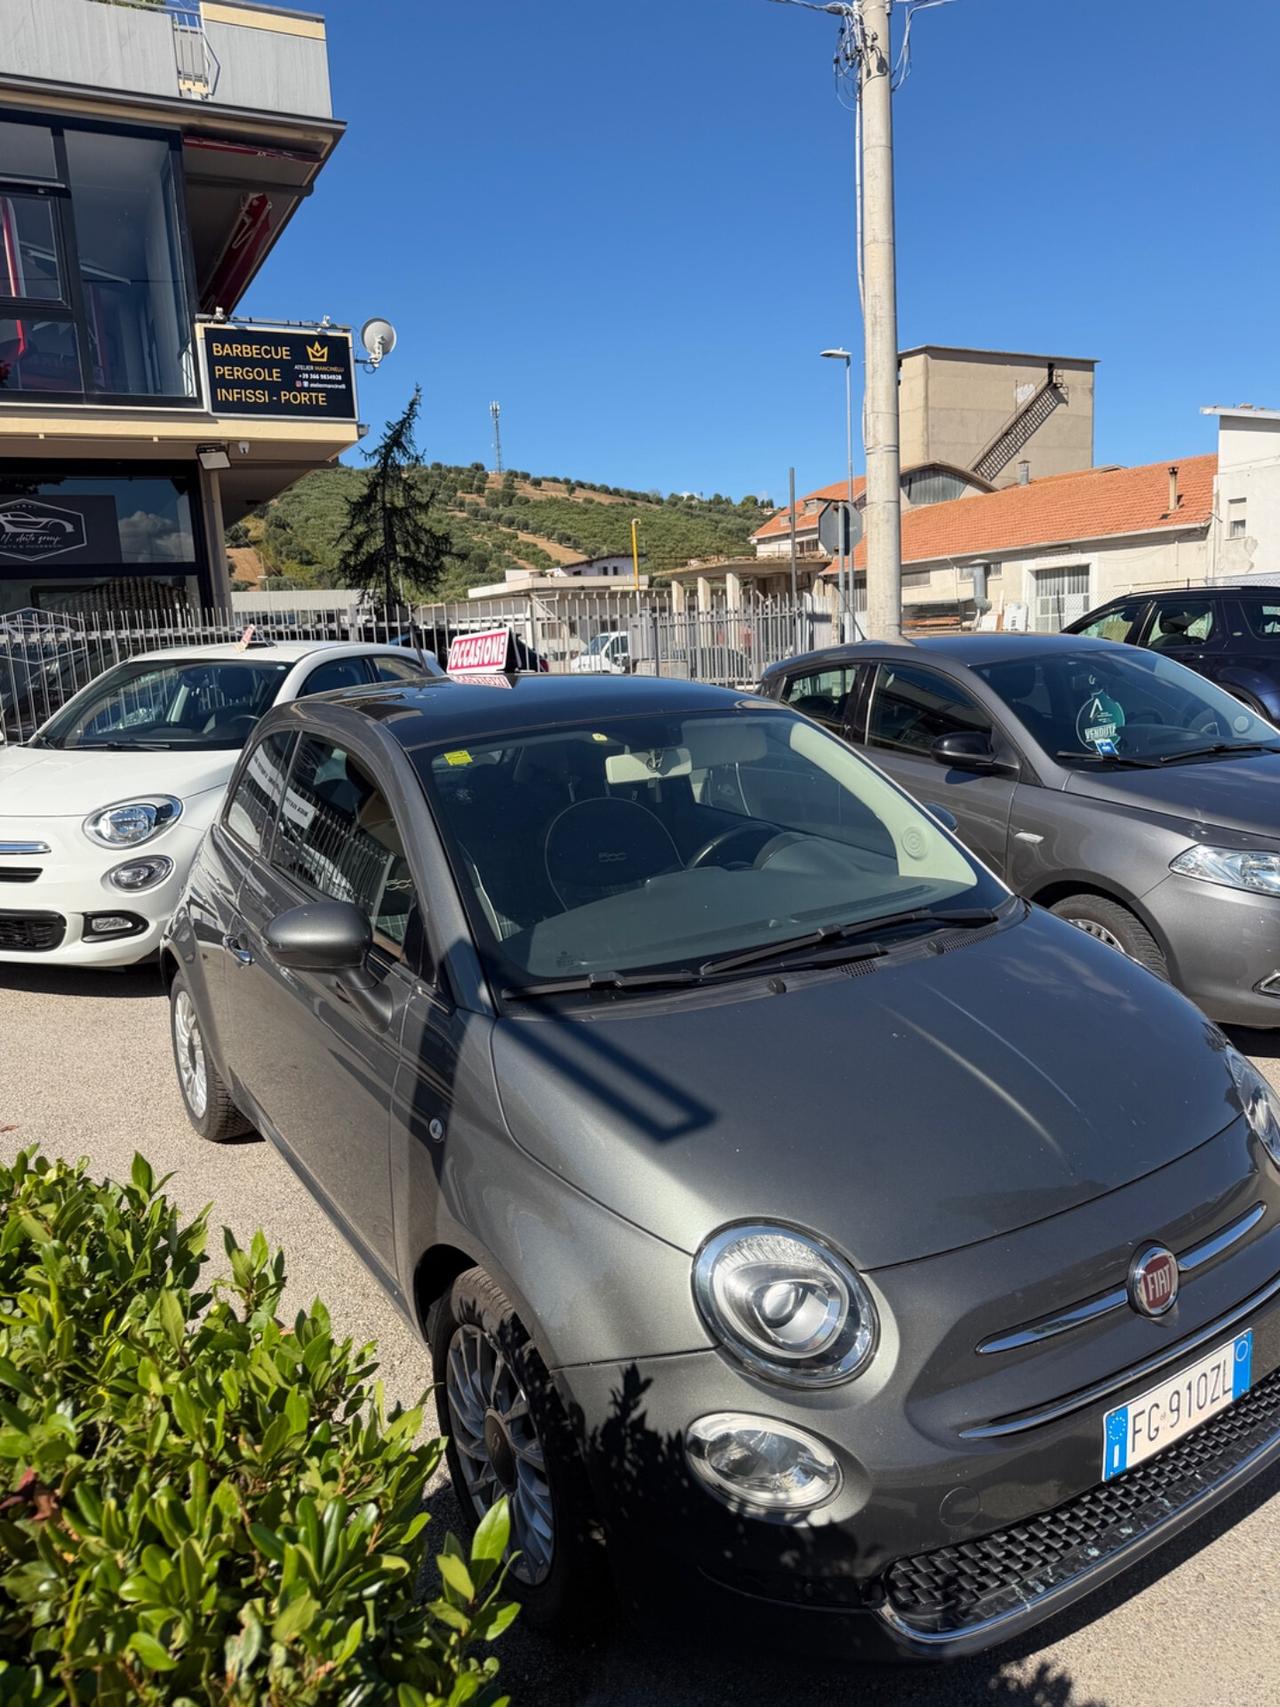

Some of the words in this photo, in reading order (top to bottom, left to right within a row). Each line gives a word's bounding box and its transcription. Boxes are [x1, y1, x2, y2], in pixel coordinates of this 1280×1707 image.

[212, 343, 291, 359] BARBECUE
[214, 366, 282, 381] PERGOLE
[216, 388, 269, 403] INFISSI
[280, 391, 327, 405] PORTE
[449, 635, 505, 668] OCCASIONE
[1147, 1265, 1170, 1301] FIAT
